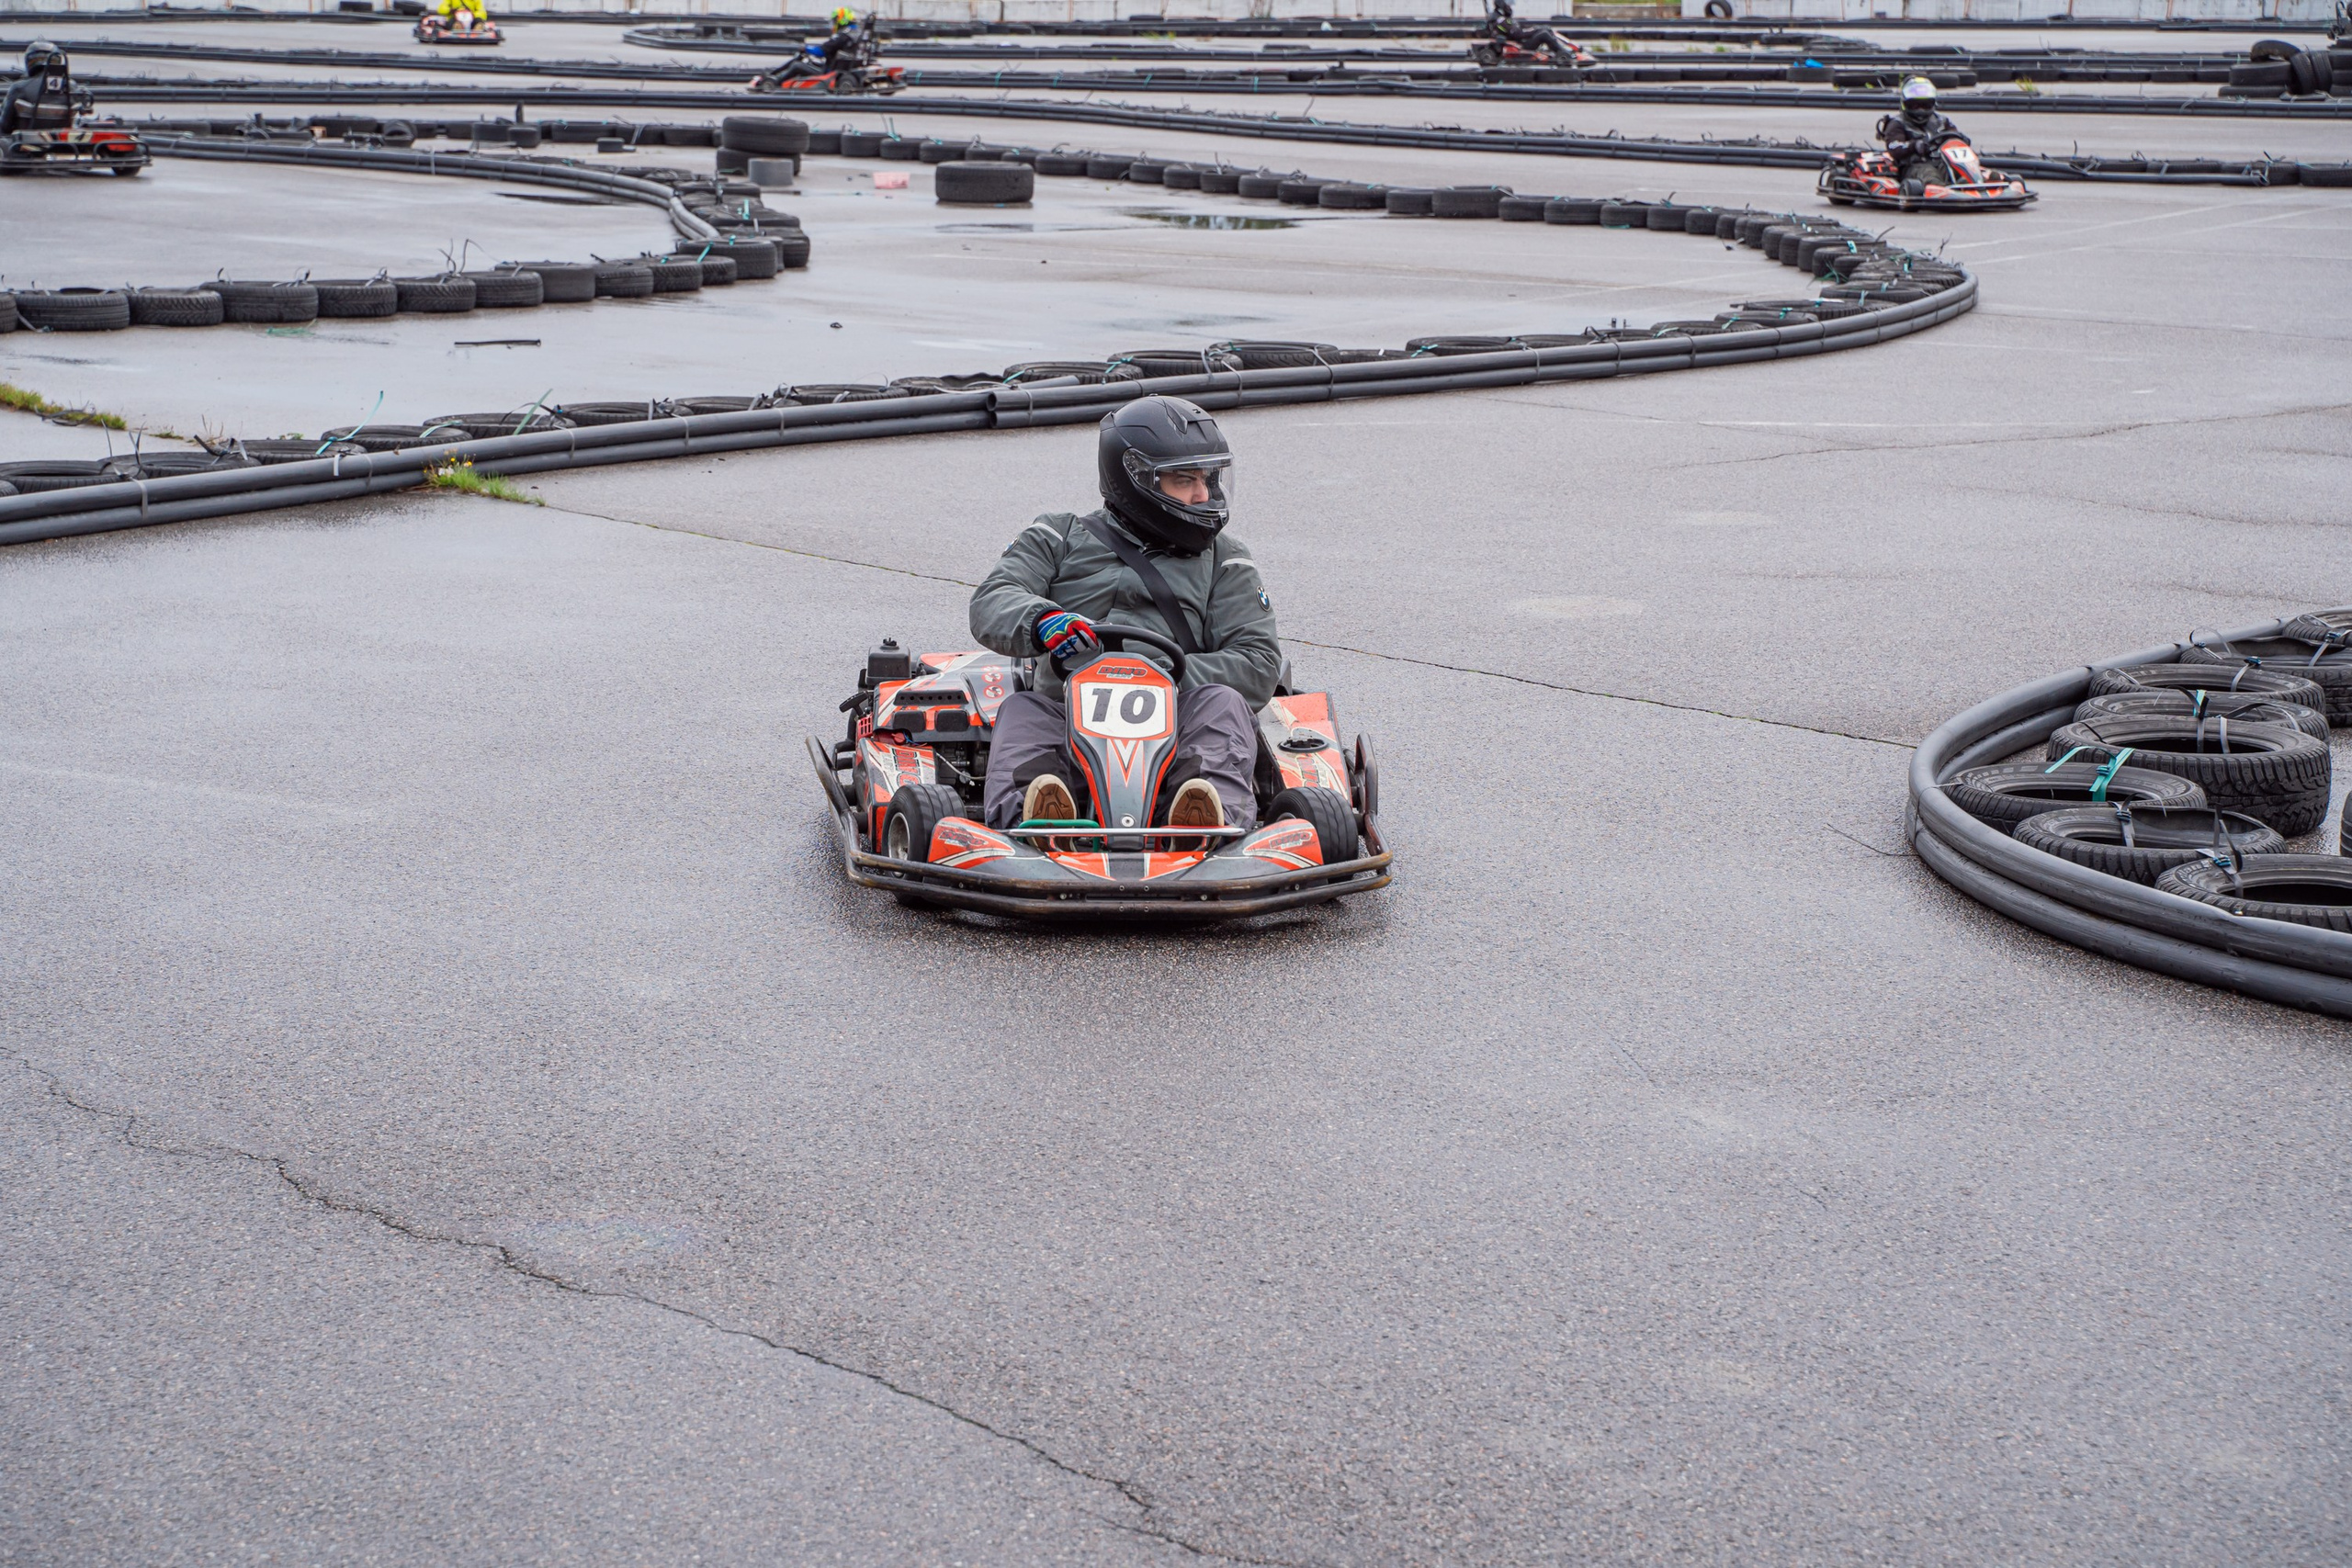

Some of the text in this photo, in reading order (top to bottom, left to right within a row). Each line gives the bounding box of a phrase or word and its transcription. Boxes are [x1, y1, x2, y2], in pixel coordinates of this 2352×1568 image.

[49, 78, 59, 89] 4
[1951, 149, 1967, 158] 17
[1098, 666, 1148, 676] DINO
[1091, 688, 1157, 725] 10
